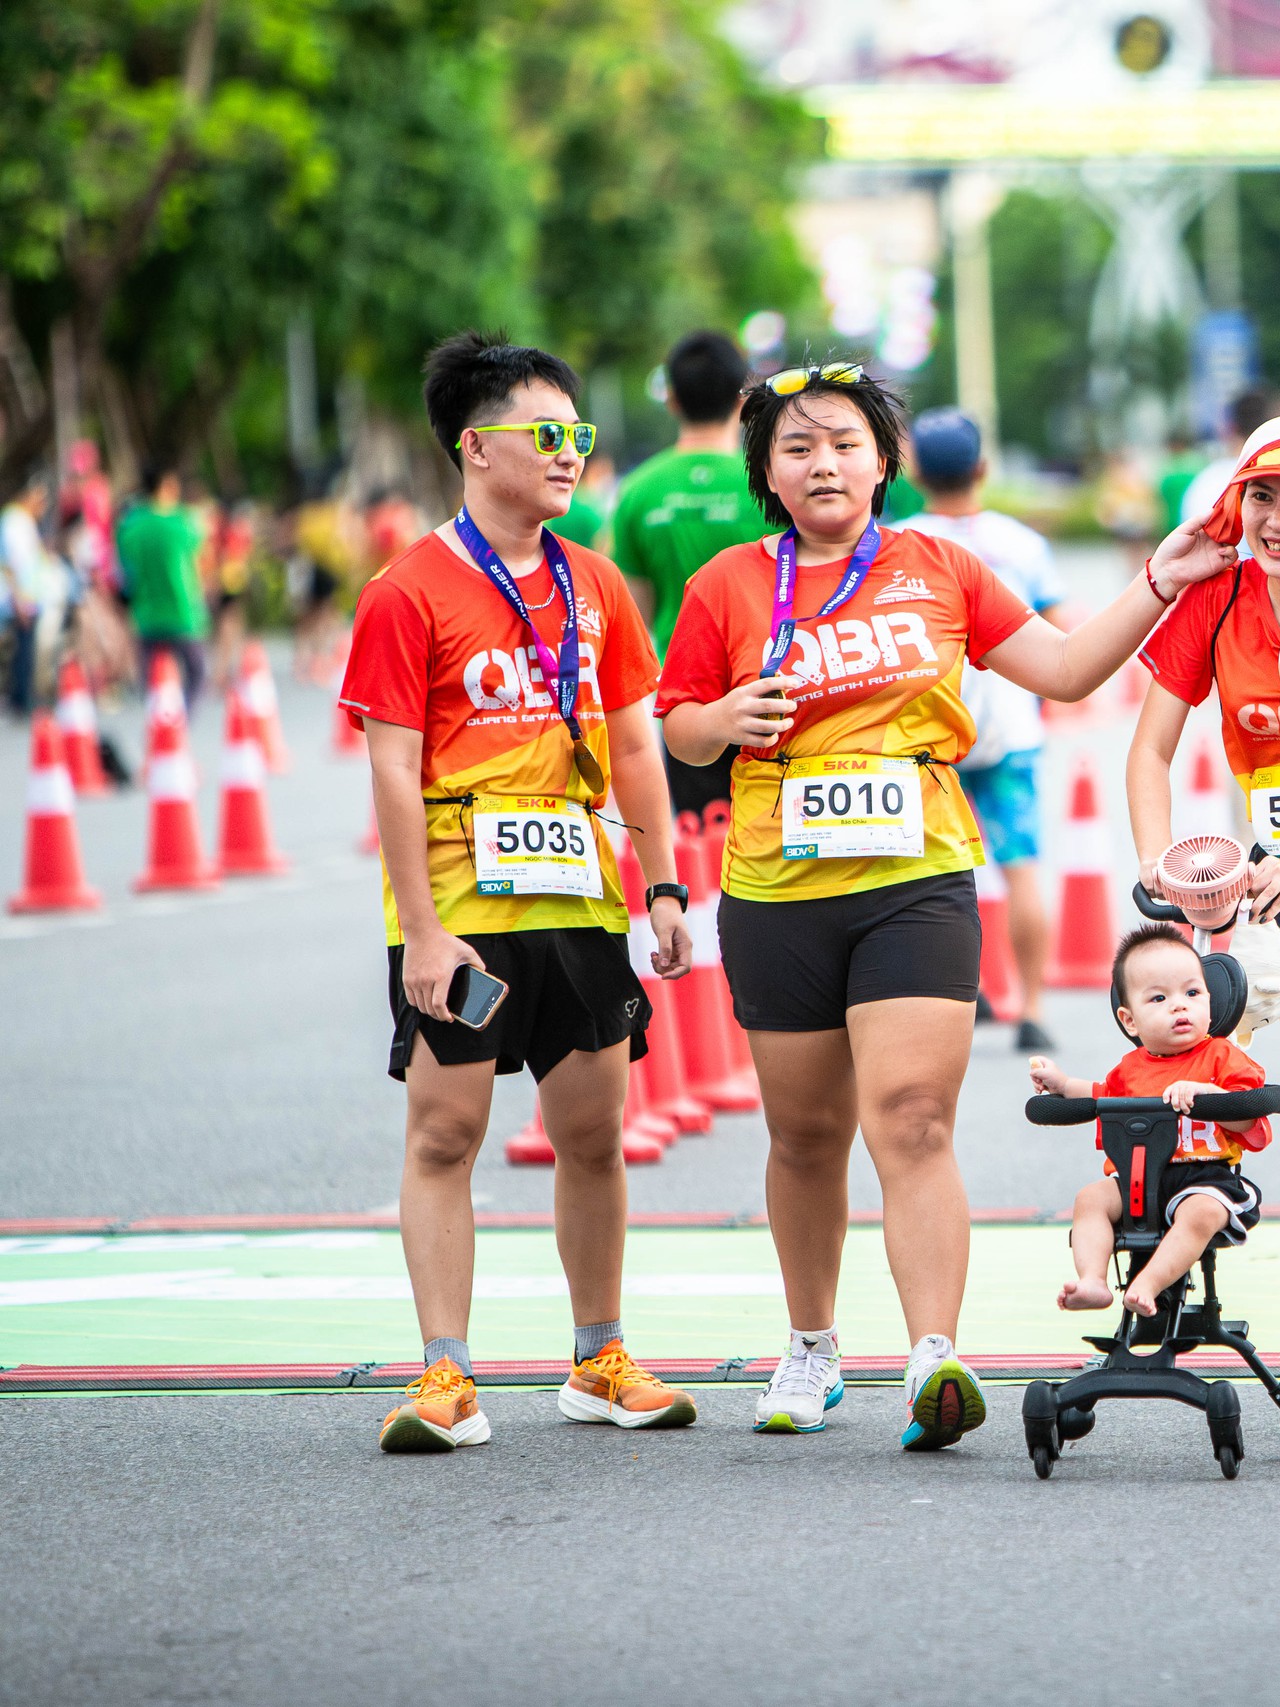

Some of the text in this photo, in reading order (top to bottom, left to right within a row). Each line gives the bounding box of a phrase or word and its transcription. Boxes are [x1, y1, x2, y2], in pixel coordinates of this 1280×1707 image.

[779, 554, 790, 603] FINISHER
[762, 612, 939, 691] QBR
[793, 668, 938, 704] ANG BINH RUNNERS
[466, 711, 606, 727] QUANG BINH RUNERS
[823, 760, 867, 771] 5KM
[517, 799, 556, 809] 5KM
[803, 782, 904, 817] 5010
[497, 820, 585, 856] 5035
[786, 847, 808, 857] BIDV
[481, 883, 503, 893] BIDV
